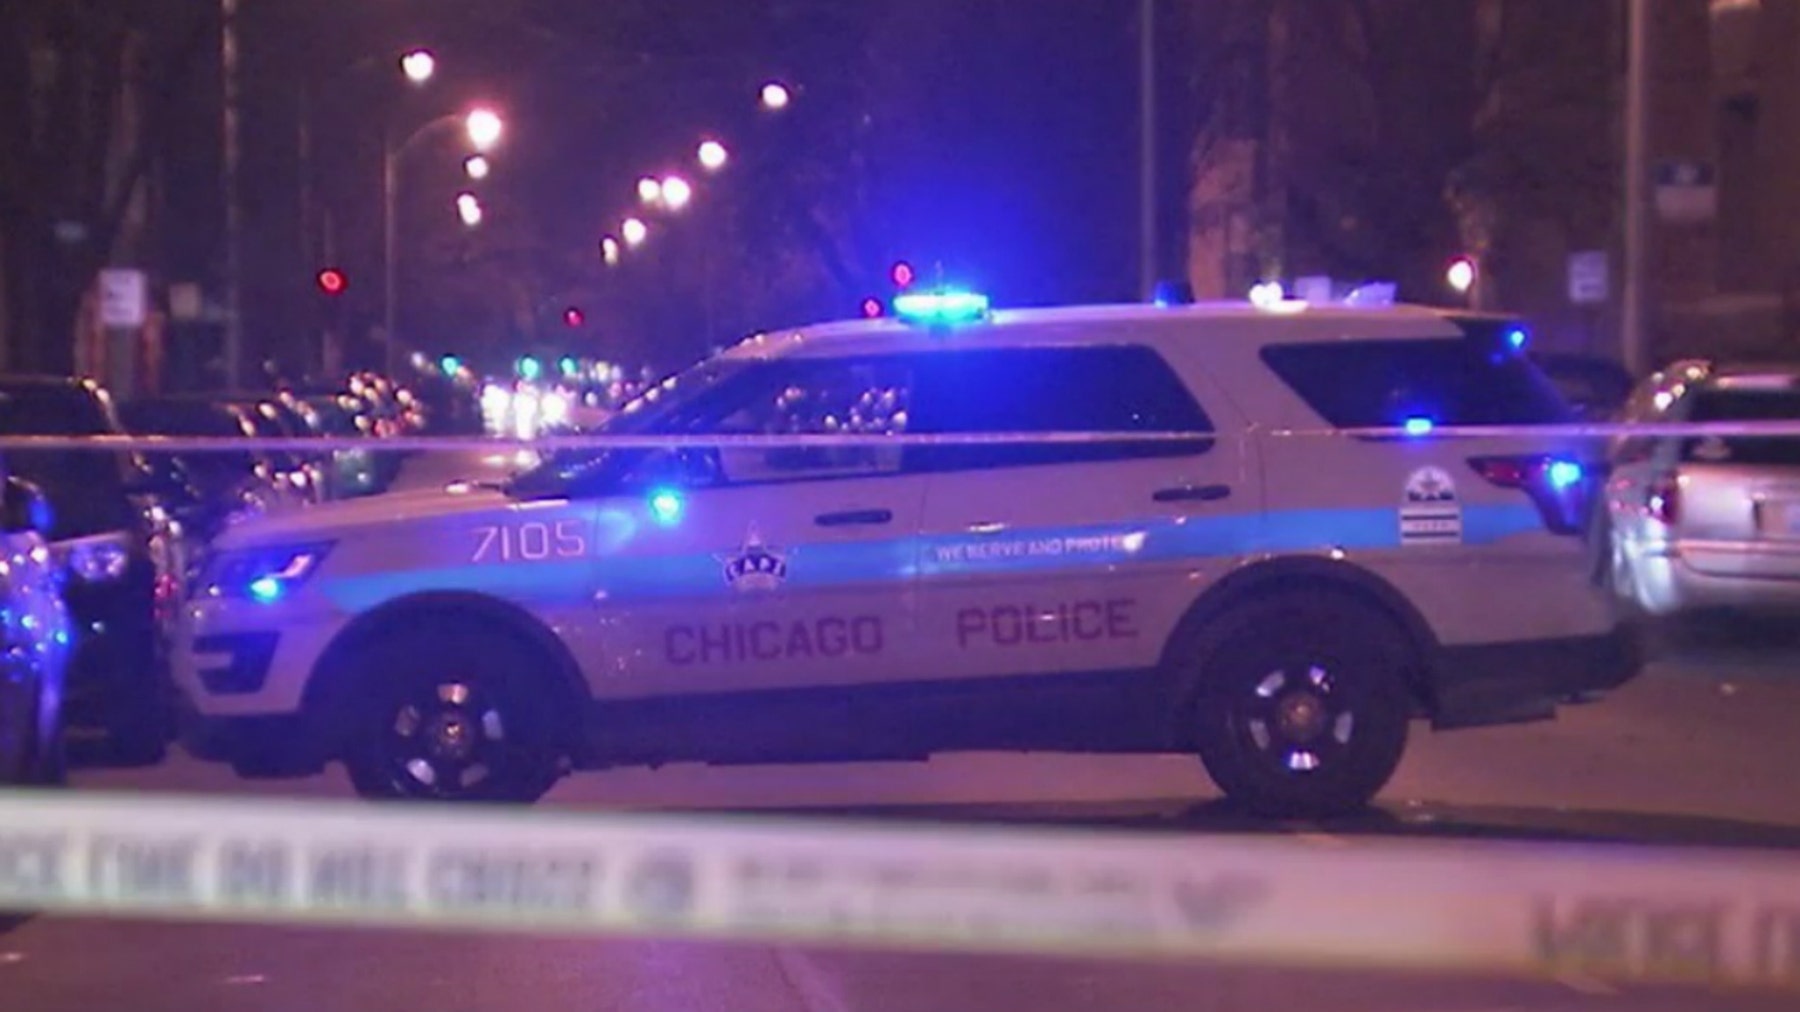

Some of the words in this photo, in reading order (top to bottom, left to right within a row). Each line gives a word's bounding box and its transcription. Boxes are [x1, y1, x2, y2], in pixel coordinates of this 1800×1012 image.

[471, 520, 585, 562] 7105
[1028, 538, 1062, 556] AND
[663, 614, 885, 667] CHICAGO
[956, 599, 1140, 649] POLICE
